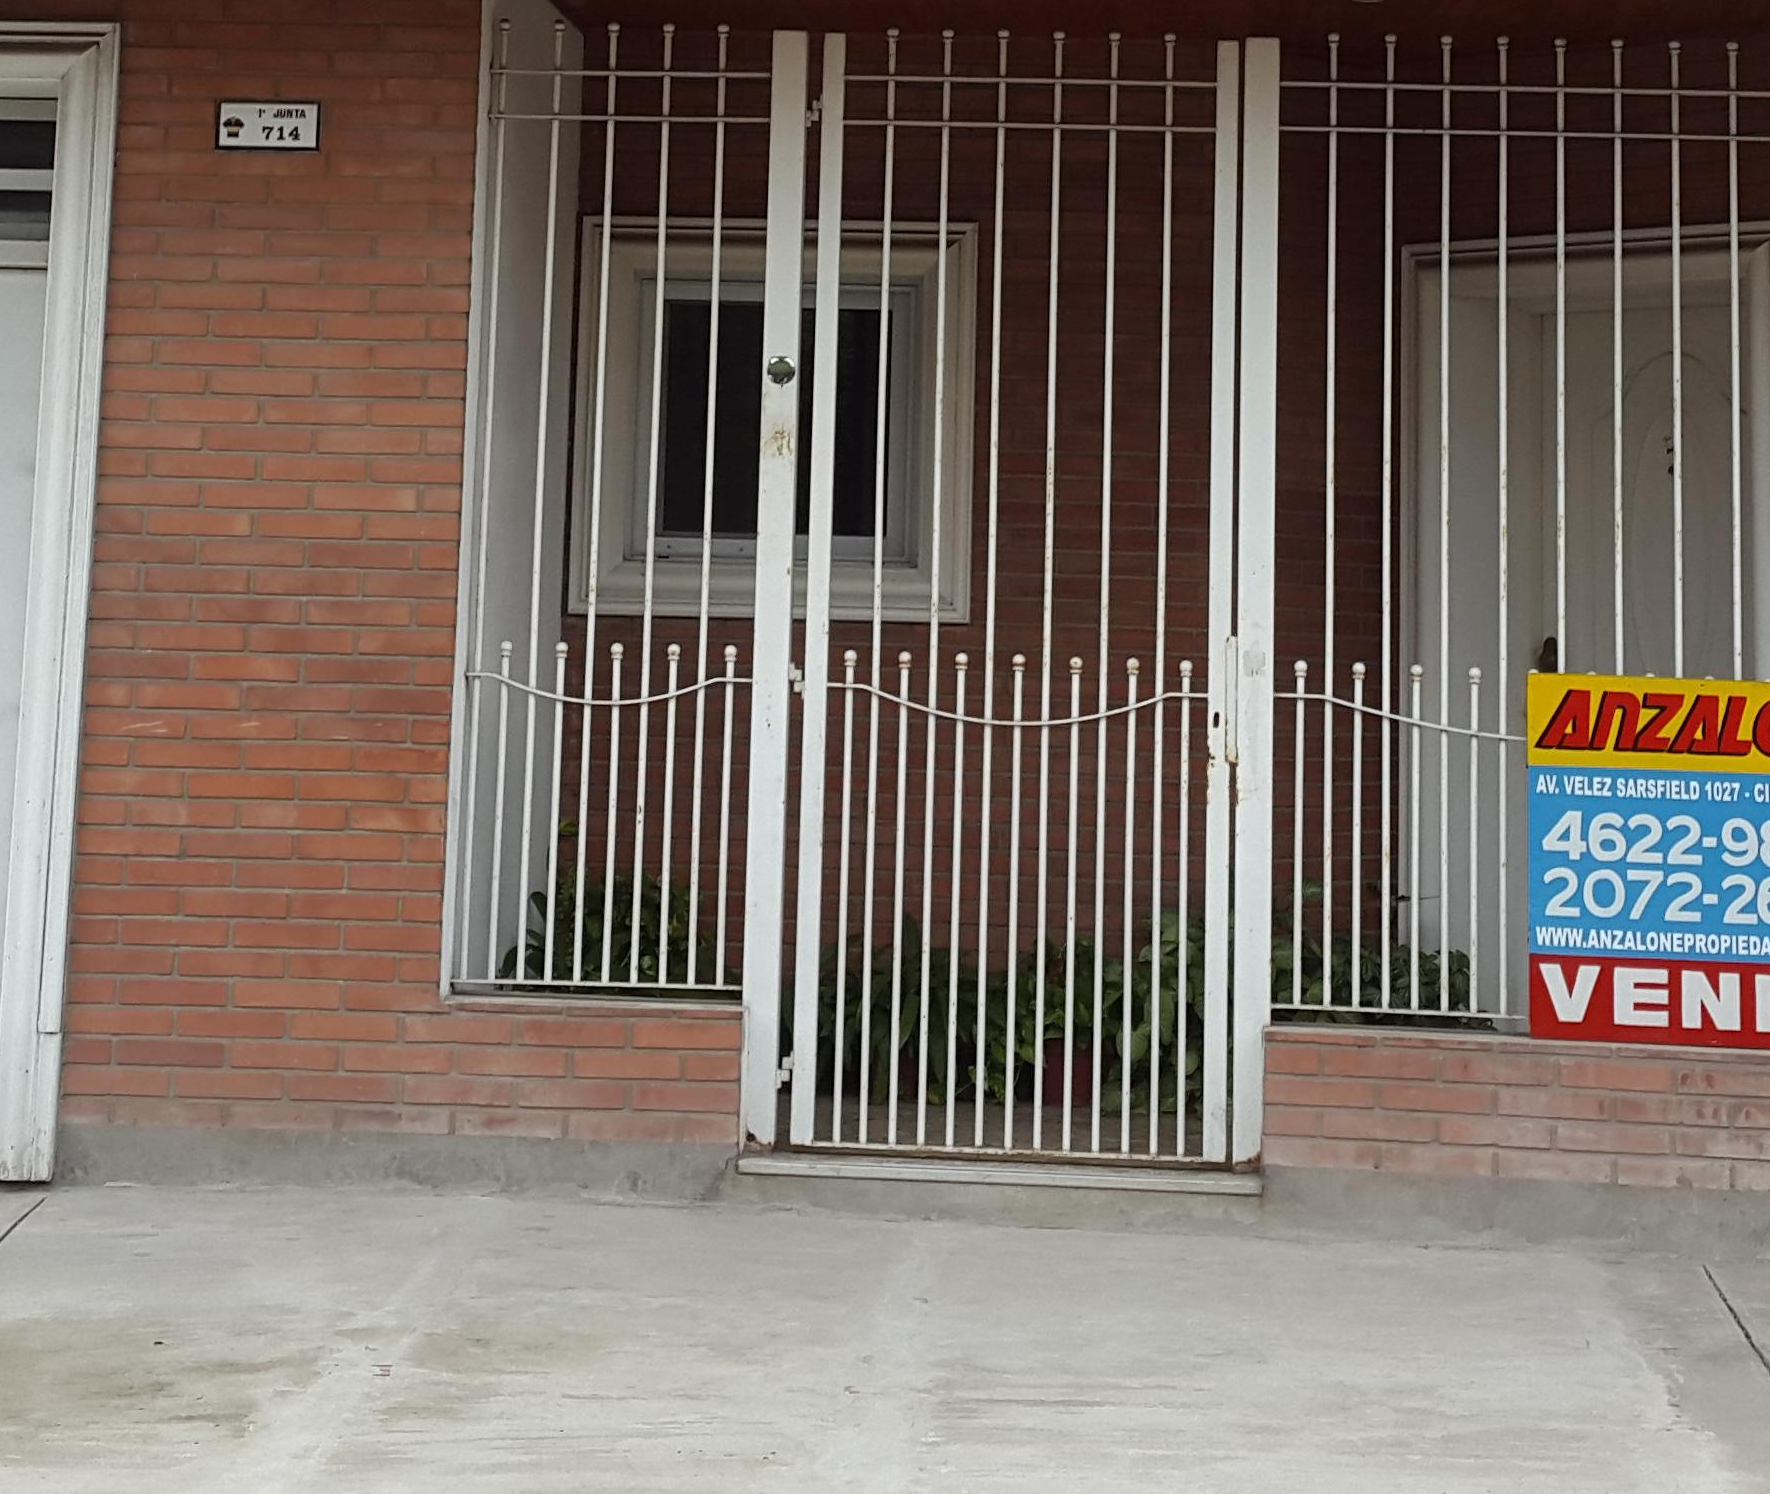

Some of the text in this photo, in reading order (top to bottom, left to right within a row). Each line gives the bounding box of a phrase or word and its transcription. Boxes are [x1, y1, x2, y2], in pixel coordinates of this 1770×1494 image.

[273, 108, 306, 119] JUNTA
[262, 126, 300, 141] 714
[1536, 774, 1559, 795] AV.
[1563, 775, 1612, 797] VELEZ
[1616, 777, 1700, 801] SARSFIELD
[1705, 781, 1741, 802] 1027
